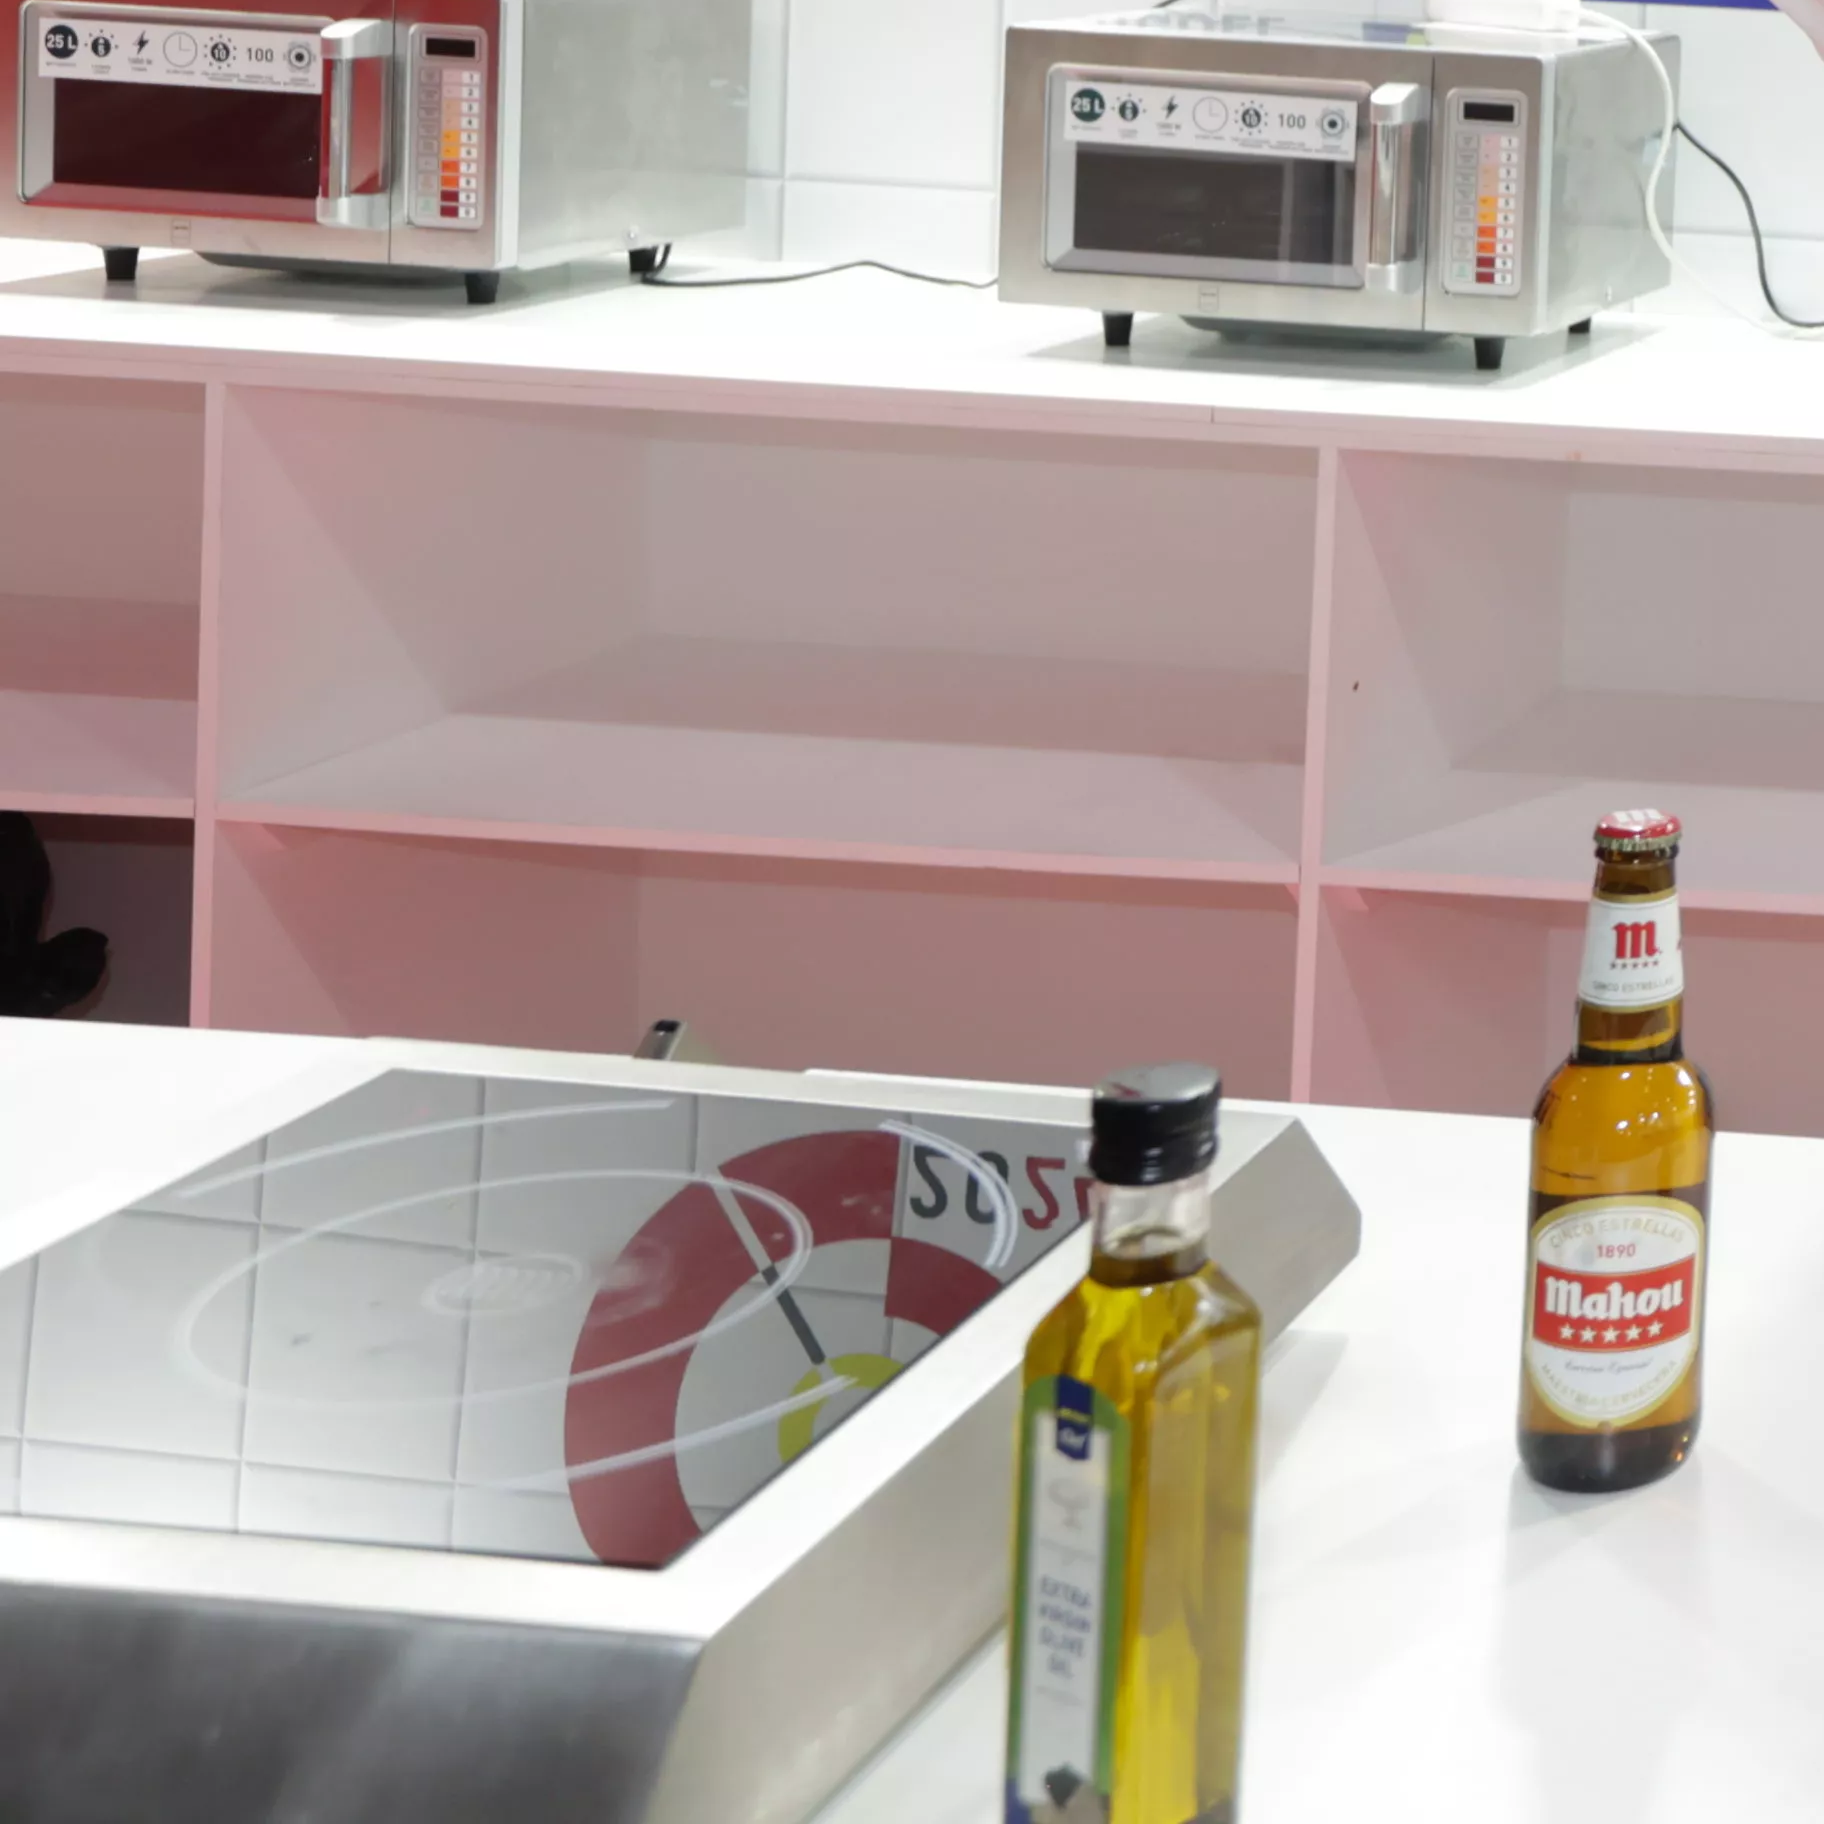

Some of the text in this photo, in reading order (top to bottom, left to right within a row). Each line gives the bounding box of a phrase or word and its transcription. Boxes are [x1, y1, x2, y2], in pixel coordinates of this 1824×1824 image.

[46, 34, 63, 48] 25
[247, 48, 273, 62] 100
[1072, 98, 1090, 112] 25
[1277, 113, 1306, 129] 100
[1550, 1218, 1684, 1248] CINCO ESTRELLAS
[1596, 1243, 1636, 1258] 1890
[1545, 1276, 1684, 1321] Mahou
